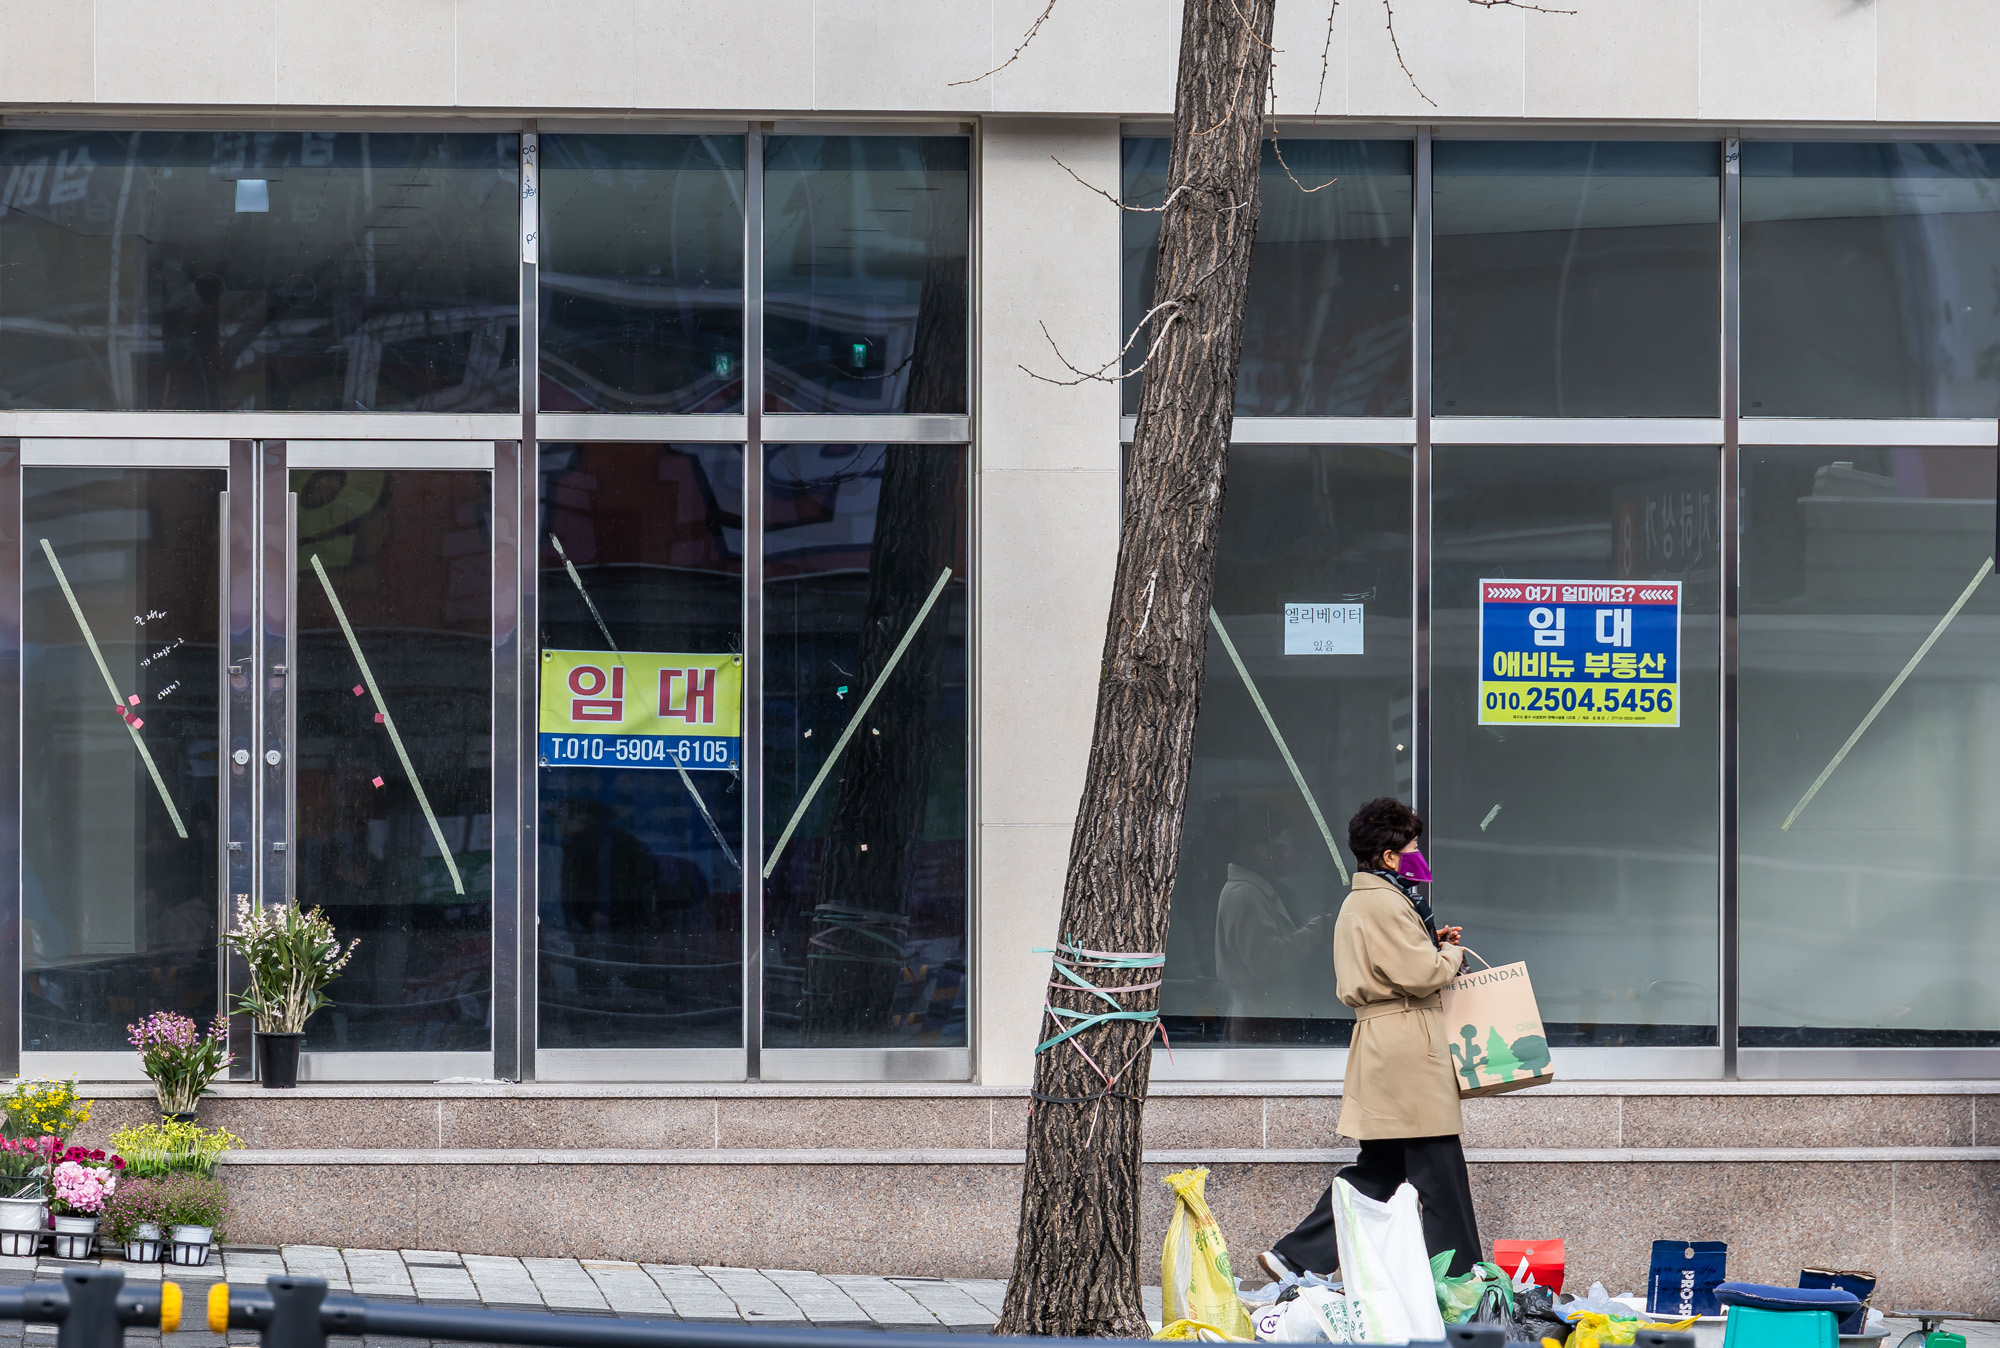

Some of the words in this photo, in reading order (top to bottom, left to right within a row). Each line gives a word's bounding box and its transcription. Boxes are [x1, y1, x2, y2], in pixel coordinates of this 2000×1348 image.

[1525, 586, 1557, 602] 여기
[1561, 586, 1636, 603] 얼마에요?
[1285, 607, 1361, 624] 엘리베이터
[1313, 640, 1335, 652] 있음
[1493, 651, 1575, 678] 애비뉴
[1584, 652, 1667, 679] 부동산
[1485, 687, 1673, 713] 010.2504.5456
[552, 738, 728, 763] T.010-5904-6105
[1458, 967, 1524, 990] HYUNDAI
